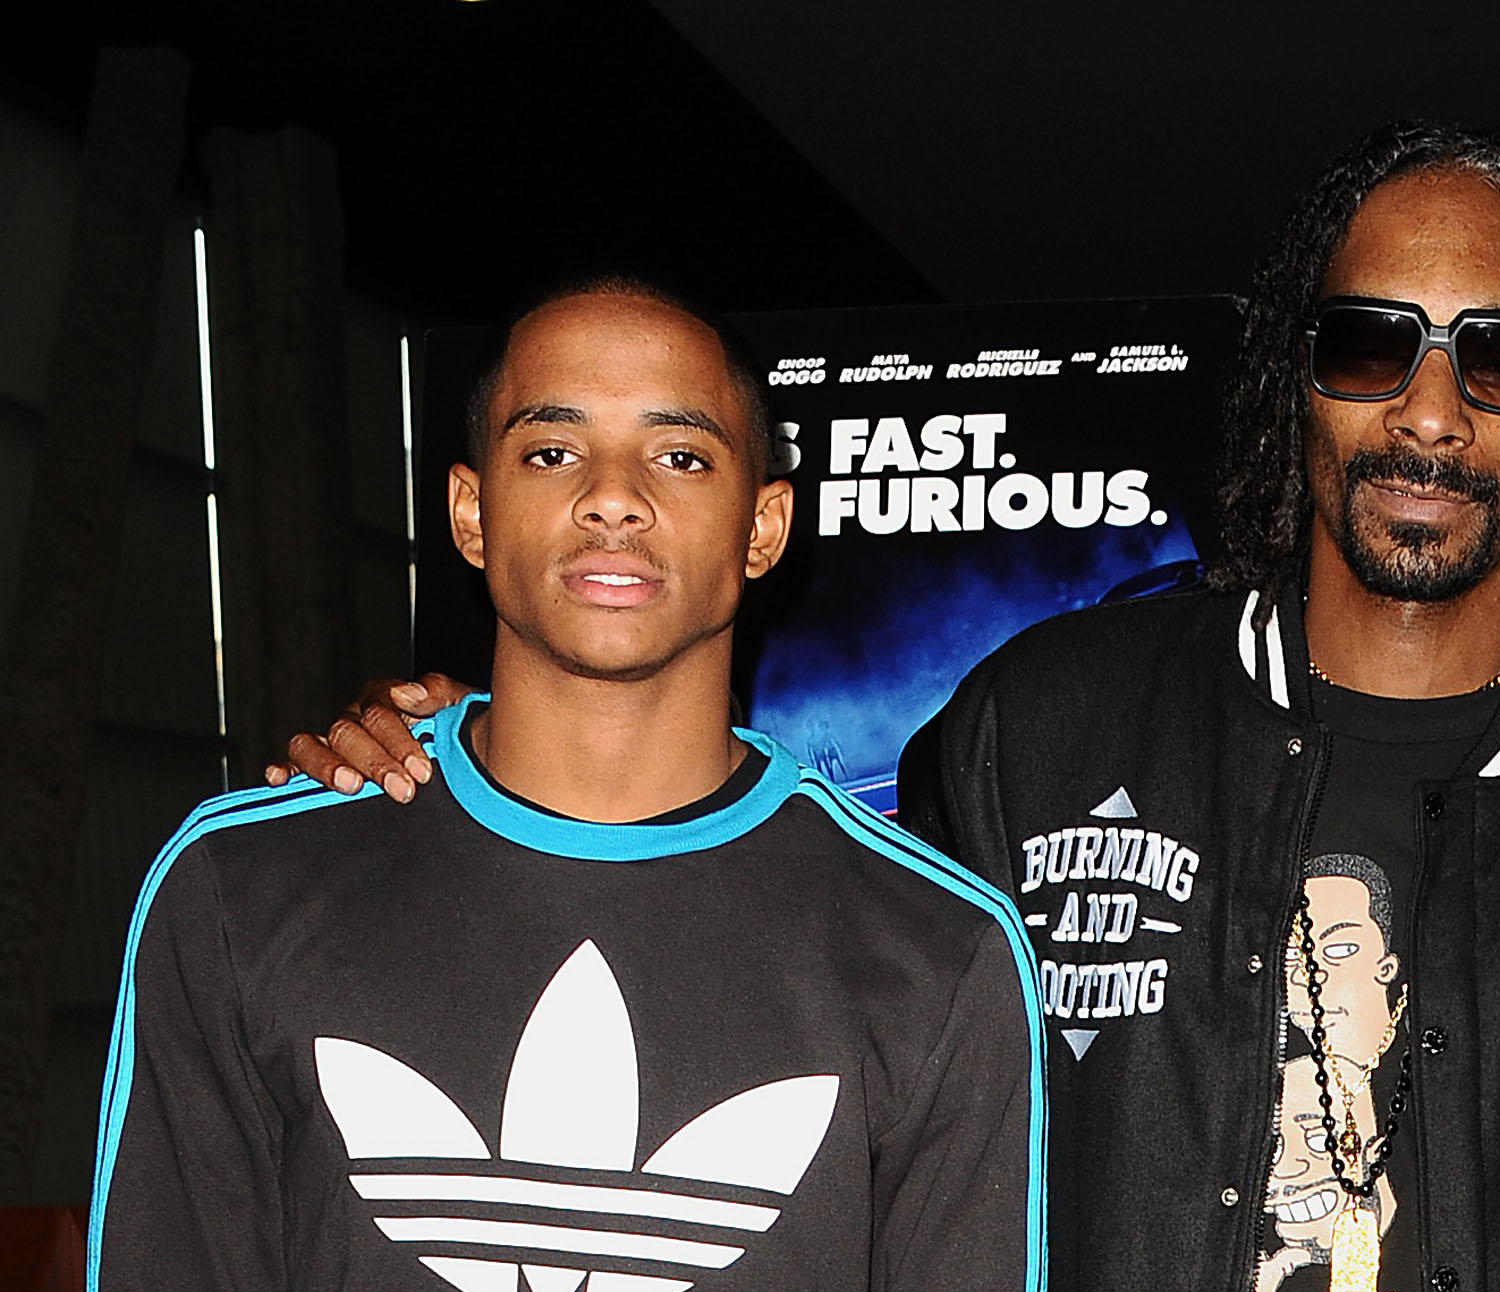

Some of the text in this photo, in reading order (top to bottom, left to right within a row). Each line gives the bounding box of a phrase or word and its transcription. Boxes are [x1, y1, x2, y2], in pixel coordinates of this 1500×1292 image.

[871, 354, 909, 366] MAYA
[977, 349, 1040, 362] MICHELLE
[1071, 352, 1096, 362] AND
[1110, 345, 1166, 357] SAMUEL
[777, 357, 826, 370] SNOOP
[946, 360, 1063, 379] RODRIGUEZ
[1096, 356, 1189, 374] JACKSON
[768, 369, 826, 386] DOGG
[839, 365, 933, 383] RUDOLPH
[829, 413, 1017, 474] FAST.
[818, 469, 1169, 537] FURIOUS.
[1021, 827, 1200, 902] BURNING
[1051, 892, 1138, 943] AND
[1041, 959, 1168, 1018] OOTING
